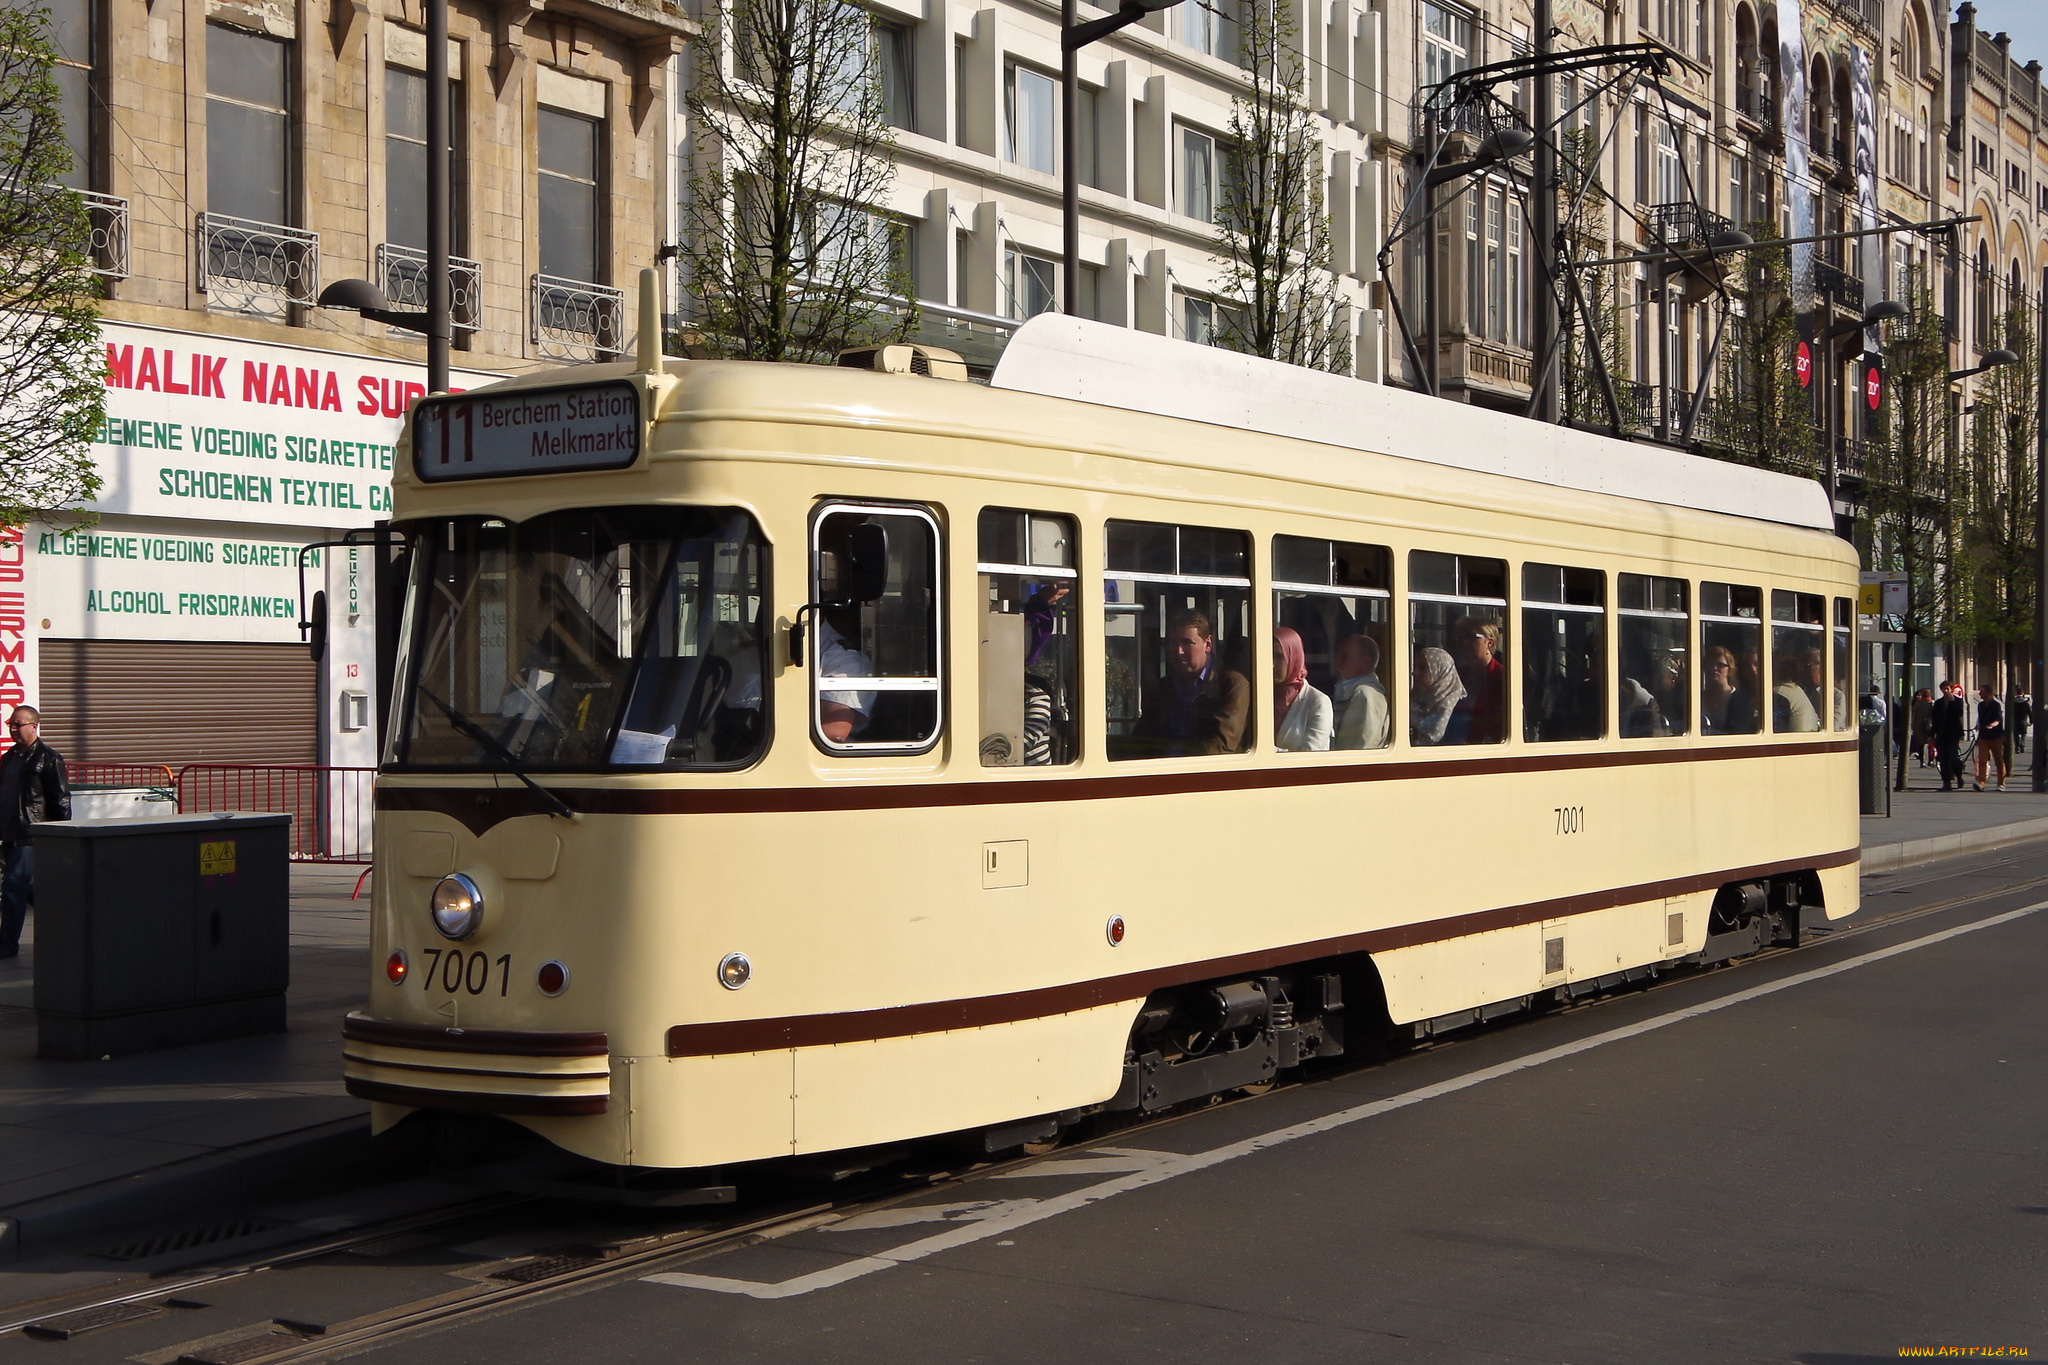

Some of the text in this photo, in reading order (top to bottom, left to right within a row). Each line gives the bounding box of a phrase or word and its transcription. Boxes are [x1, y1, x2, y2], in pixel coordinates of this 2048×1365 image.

[106, 343, 228, 399] MALIK
[243, 360, 342, 413] NANA
[191, 427, 277, 461] VOEDING
[432, 393, 634, 464] 11 Berchem Station
[531, 423, 635, 457] Melkmarkt
[159, 468, 272, 503] SCHOENEN
[280, 478, 362, 510] TEXTIEL
[38, 533, 321, 569] ALGEMENE VOEDING SIGARETTEN
[87, 589, 295, 618] ALCOHOL FRISDRANKEN
[1866, 594, 1874, 604] 6
[347, 664, 358, 678] 13
[1554, 805, 1584, 835] 7001
[423, 948, 511, 997] 7001
